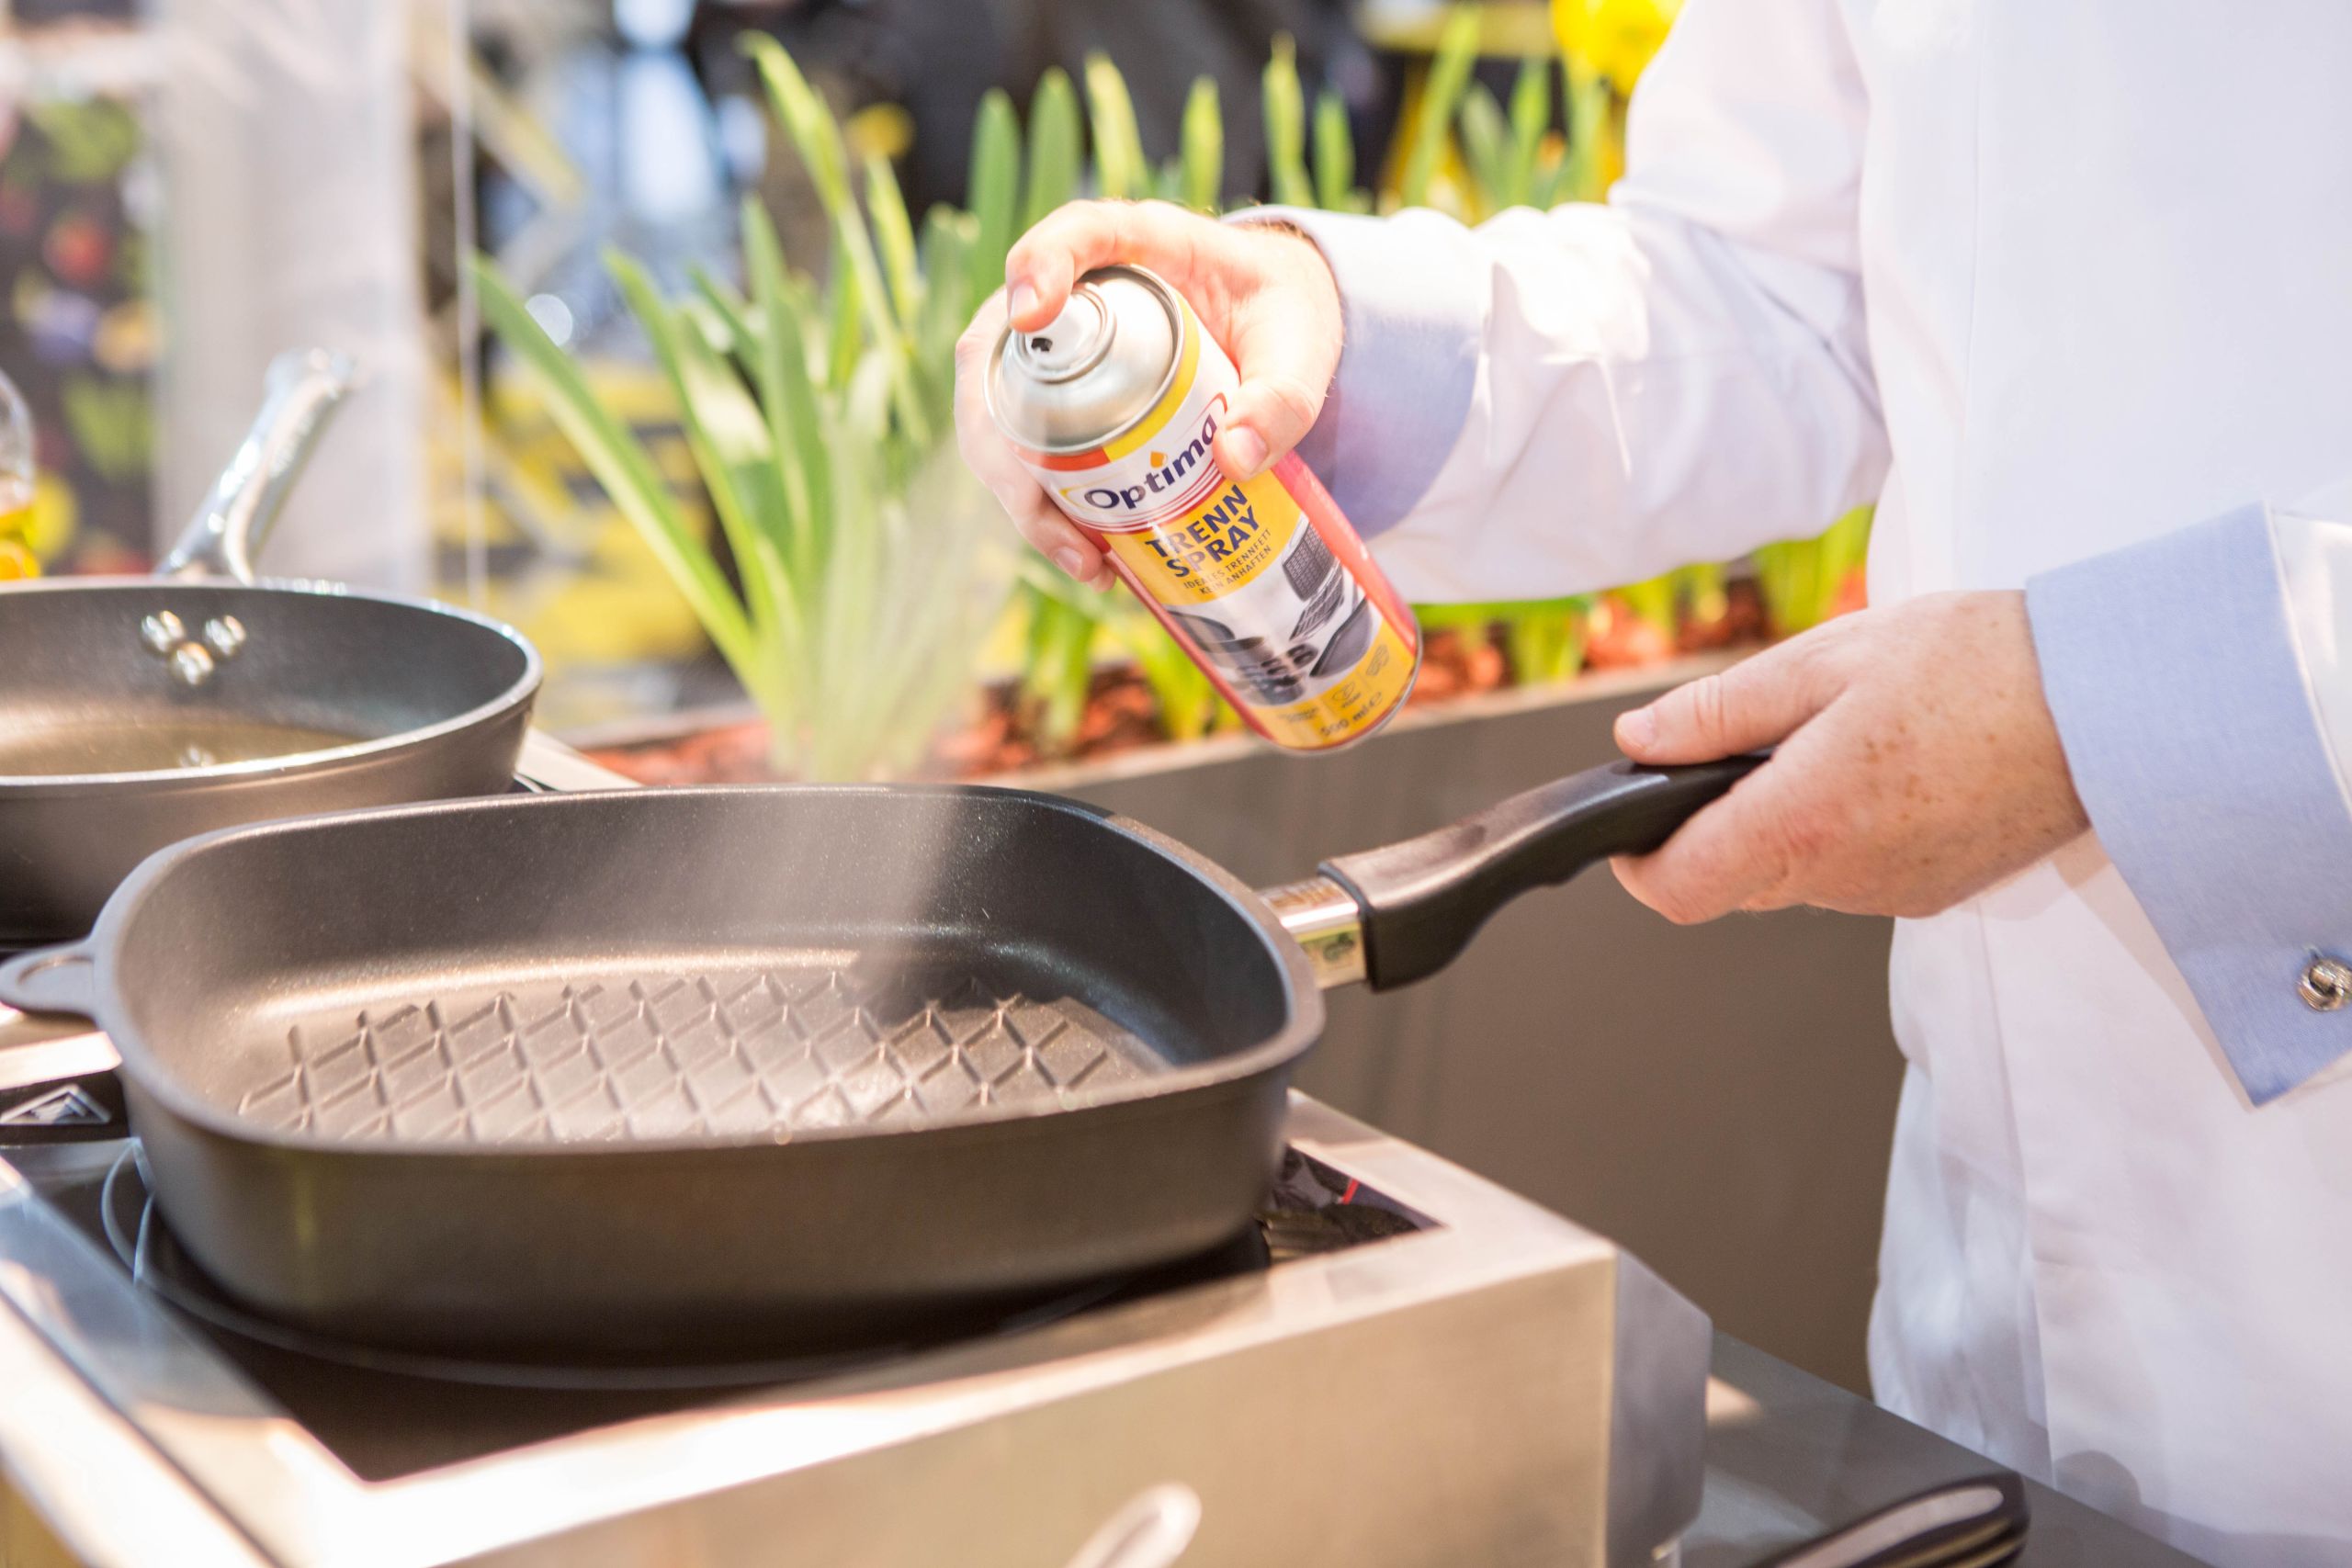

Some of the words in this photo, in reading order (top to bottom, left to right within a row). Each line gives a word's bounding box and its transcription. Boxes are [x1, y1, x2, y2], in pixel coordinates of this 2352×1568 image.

[1084, 413, 1217, 510] Optima
[1145, 484, 1249, 558] TRENN
[1166, 504, 1260, 578] SPRAY
[1183, 569, 1225, 589] IDEALES
[1226, 529, 1272, 572] TRENNFETT
[1227, 545, 1272, 584] ANHAFTEN
